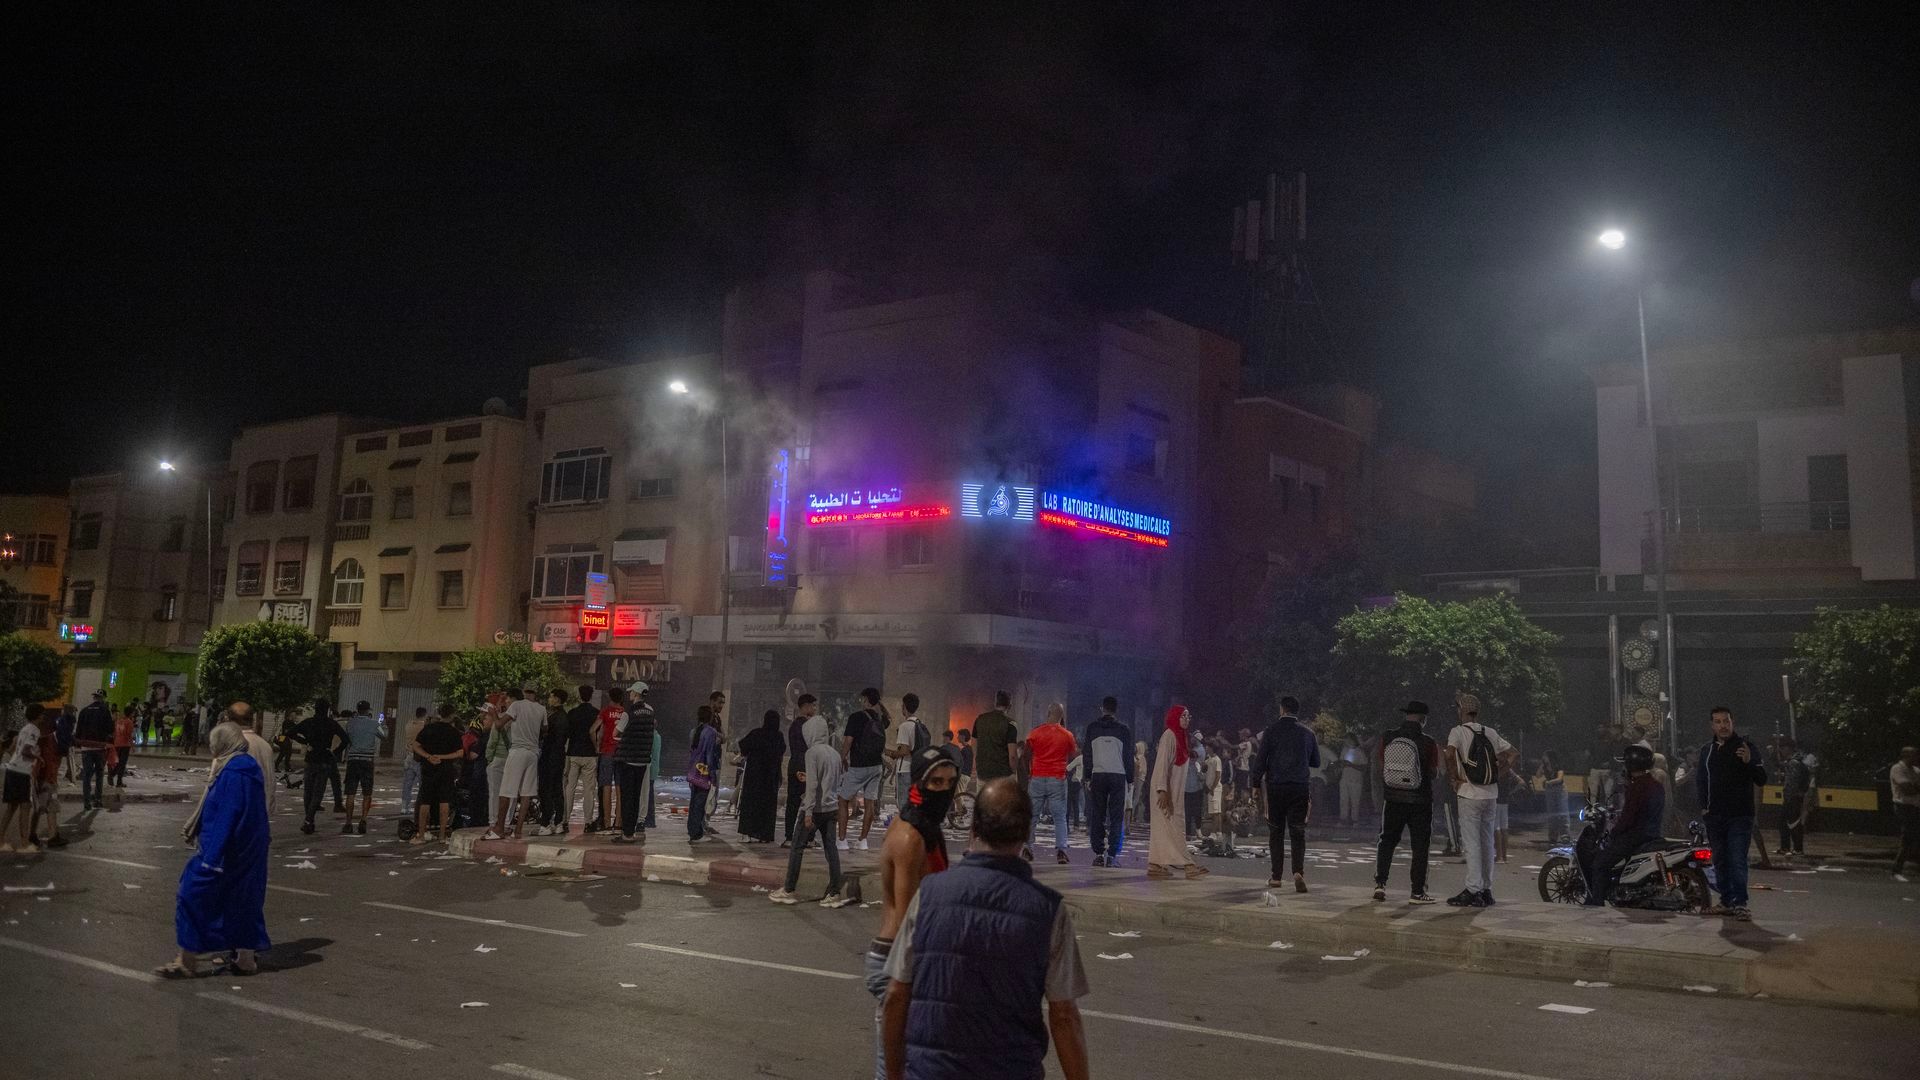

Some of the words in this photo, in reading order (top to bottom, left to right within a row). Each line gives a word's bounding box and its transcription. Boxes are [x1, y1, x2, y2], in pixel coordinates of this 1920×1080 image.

[1093, 502, 1134, 529] D'ANALYSES
[1133, 511, 1170, 536] MEDICALES
[584, 614, 606, 626] binet
